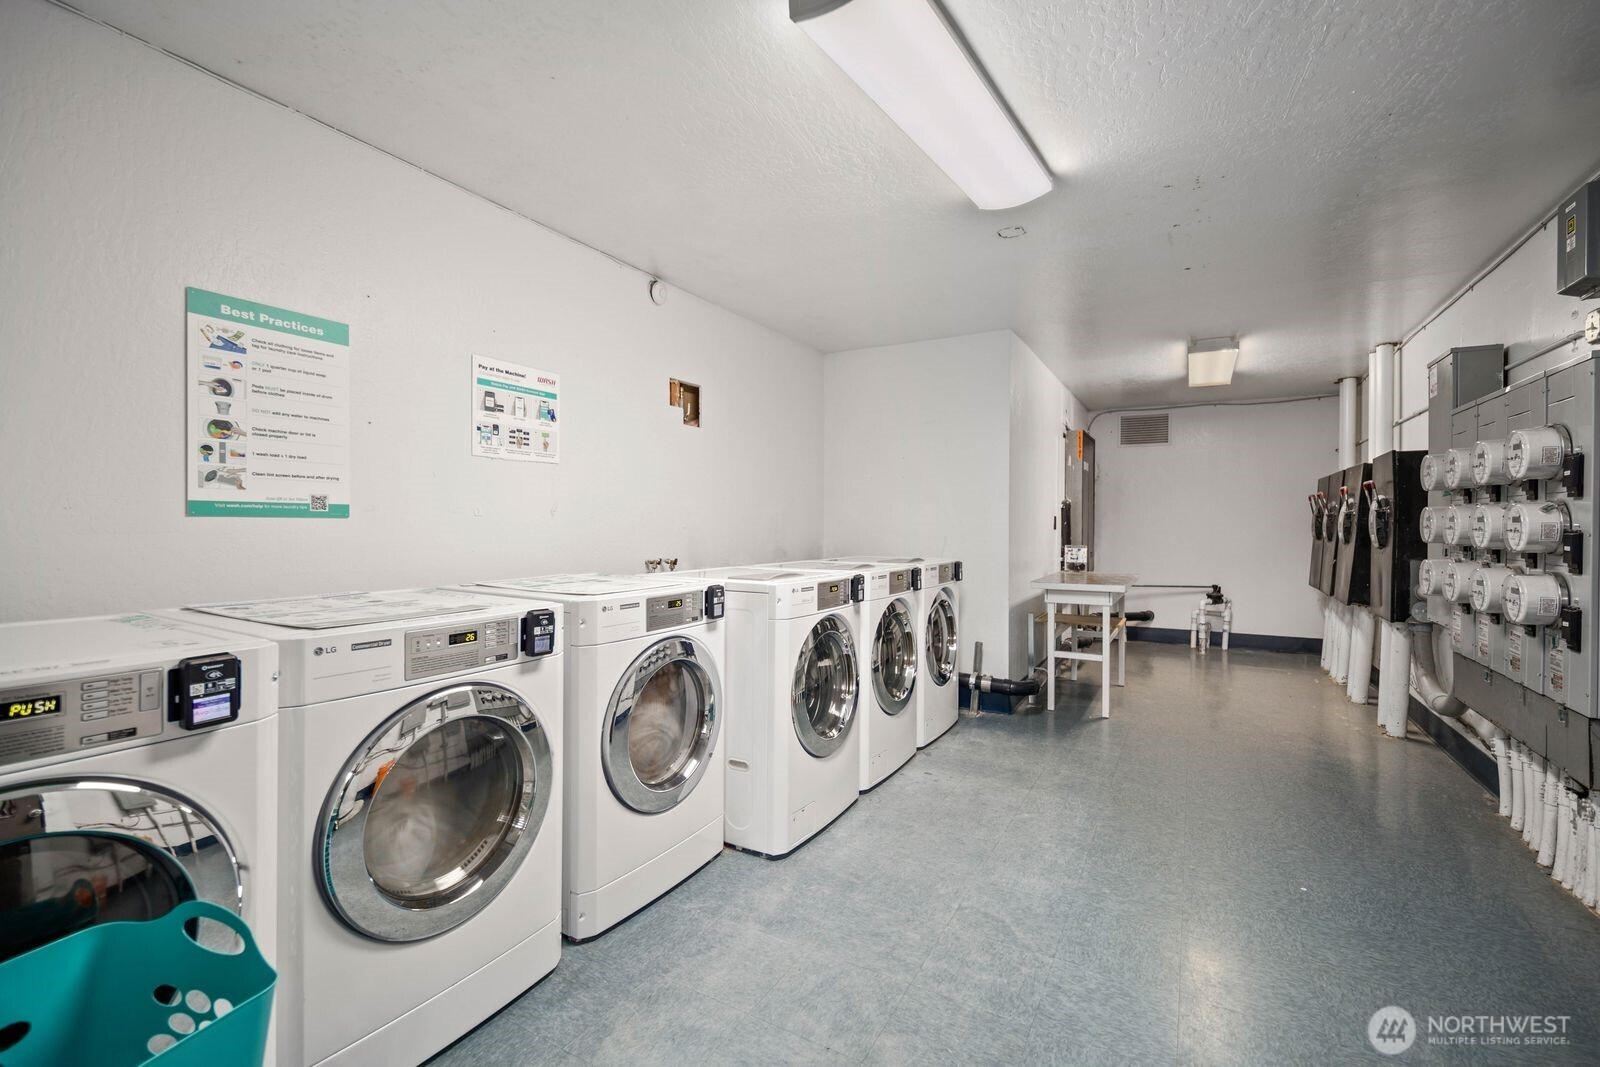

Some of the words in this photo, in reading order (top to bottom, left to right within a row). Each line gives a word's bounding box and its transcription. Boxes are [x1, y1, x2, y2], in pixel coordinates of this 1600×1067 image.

[220, 304, 255, 321] Best
[260, 313, 324, 336] Practices
[274, 342, 293, 351] clothing
[268, 346, 285, 355] laundry
[297, 352, 323, 361] instructions
[505, 370, 526, 378] Machine!
[466, 633, 475, 641] 26
[9, 698, 56, 717] PUSH
